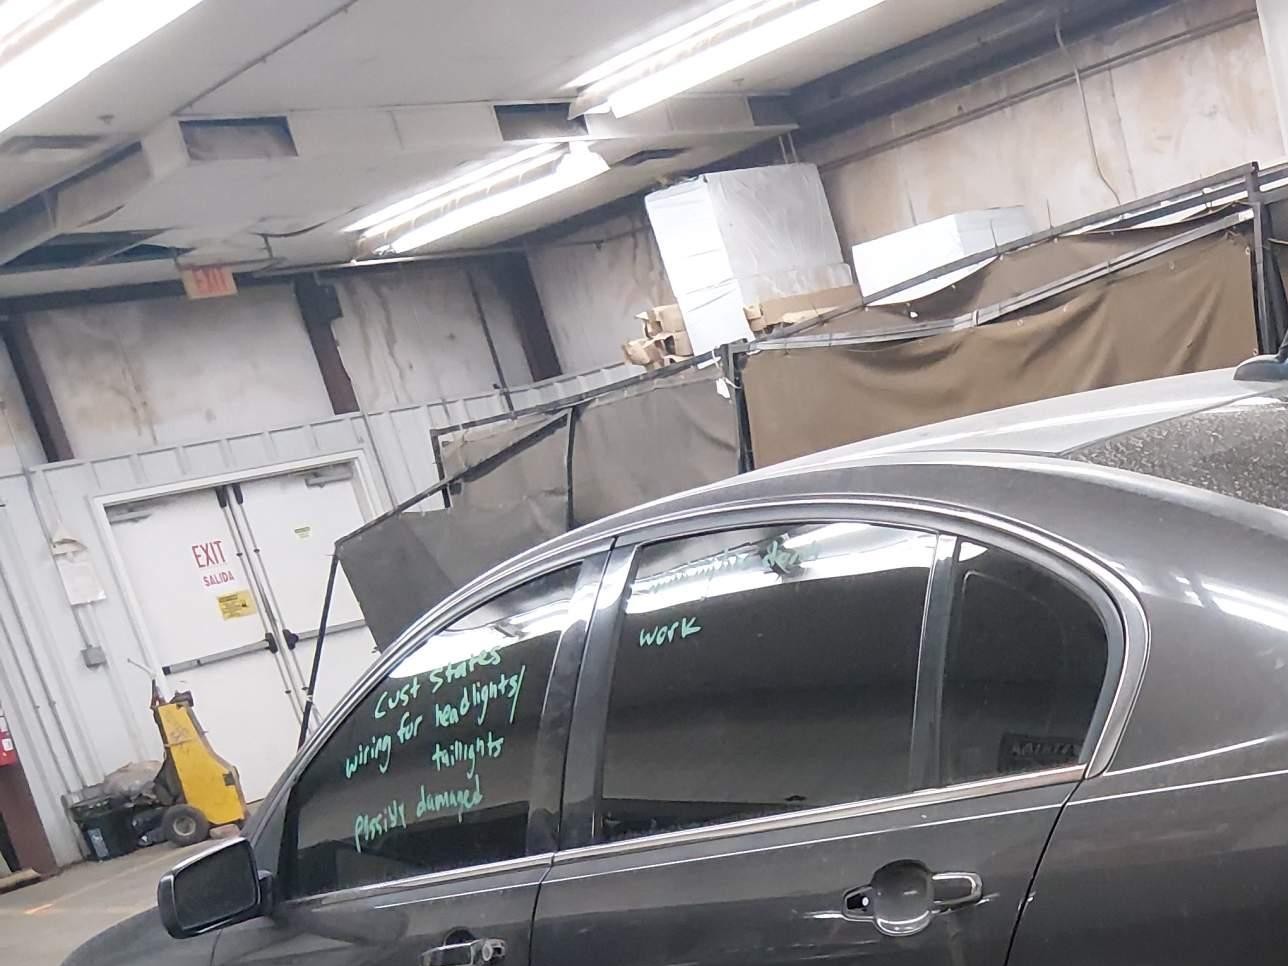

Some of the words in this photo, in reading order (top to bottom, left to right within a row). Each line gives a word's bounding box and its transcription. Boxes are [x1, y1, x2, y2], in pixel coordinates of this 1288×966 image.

[191, 267, 229, 294] EXIT
[191, 540, 226, 568] EXIT
[203, 570, 235, 587] SALIDA
[345, 735, 392, 779] wiring
[397, 711, 423, 744] for
[416, 773, 483, 824] damaged
